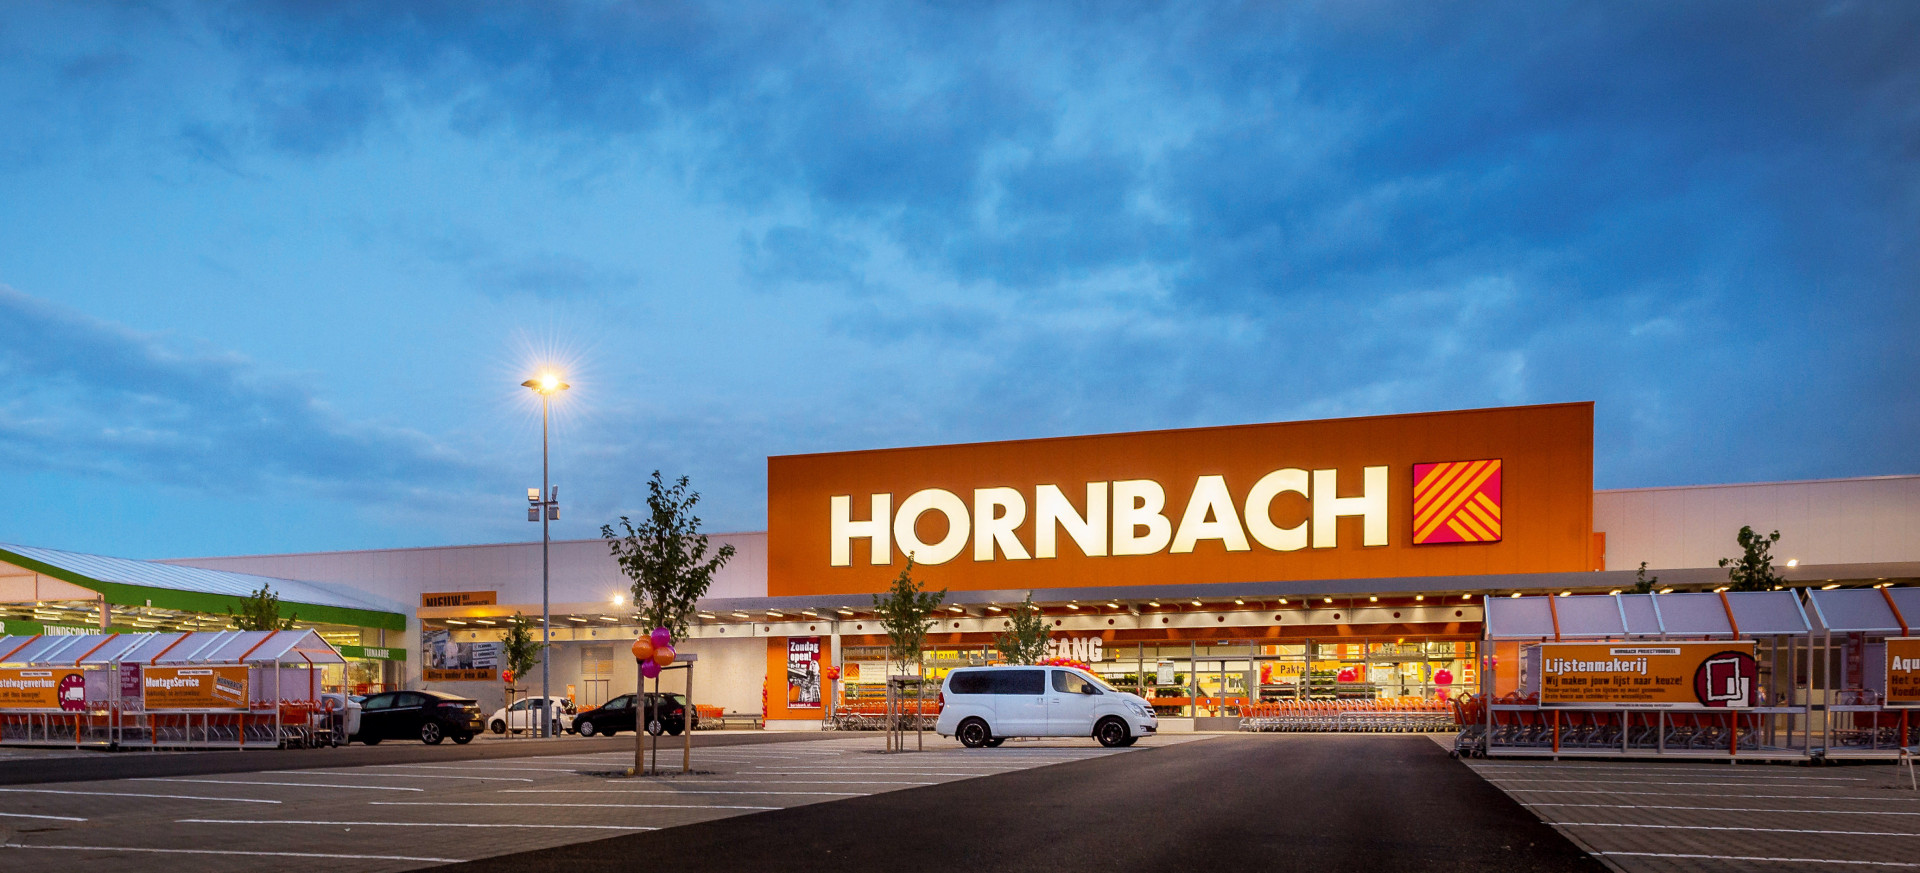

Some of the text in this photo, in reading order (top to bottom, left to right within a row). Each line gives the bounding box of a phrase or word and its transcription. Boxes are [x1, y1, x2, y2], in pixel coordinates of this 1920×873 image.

[830, 465, 1390, 567] HORNBACH
[790, 641, 819, 653] Zondag
[790, 651, 812, 663] open!
[1280, 664, 1318, 674] Paktael
[1545, 657, 1648, 675] Lijstenmakerij
[145, 676, 200, 690] MontageService
[1545, 675, 1683, 687] Wij maken jouw lijst naar keuze!
[1891, 675, 1909, 685] Het
